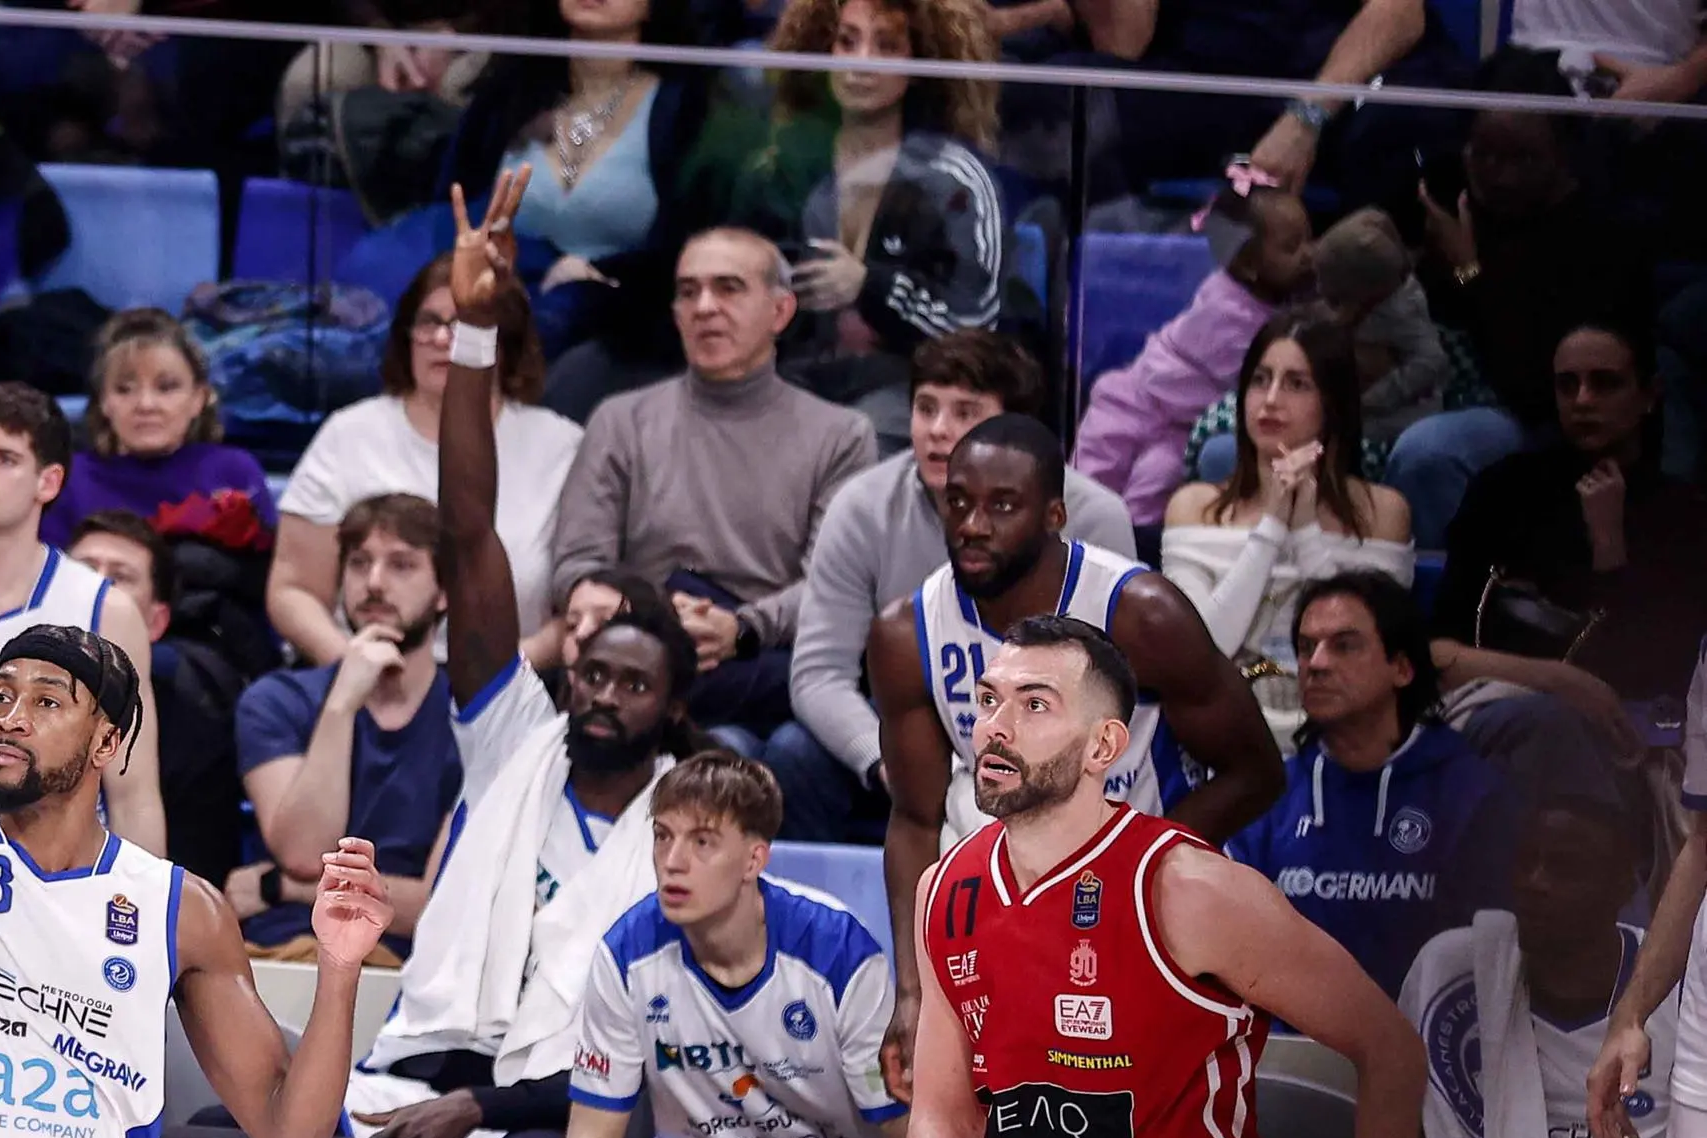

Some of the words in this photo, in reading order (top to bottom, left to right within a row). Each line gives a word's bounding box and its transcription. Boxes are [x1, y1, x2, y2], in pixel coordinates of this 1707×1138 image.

[1313, 870, 1437, 902] GERMANI
[945, 874, 981, 940] 17
[1076, 894, 1098, 905] LBA
[111, 913, 136, 926] LBA
[947, 949, 979, 980] EA7
[40, 984, 114, 1013] METROLOGIA
[1059, 999, 1106, 1020] EA7
[1061, 1024, 1107, 1036] EYEWEAR
[52, 1033, 147, 1092] MEGRANI
[1047, 1050, 1133, 1070] SIMMENTHAL
